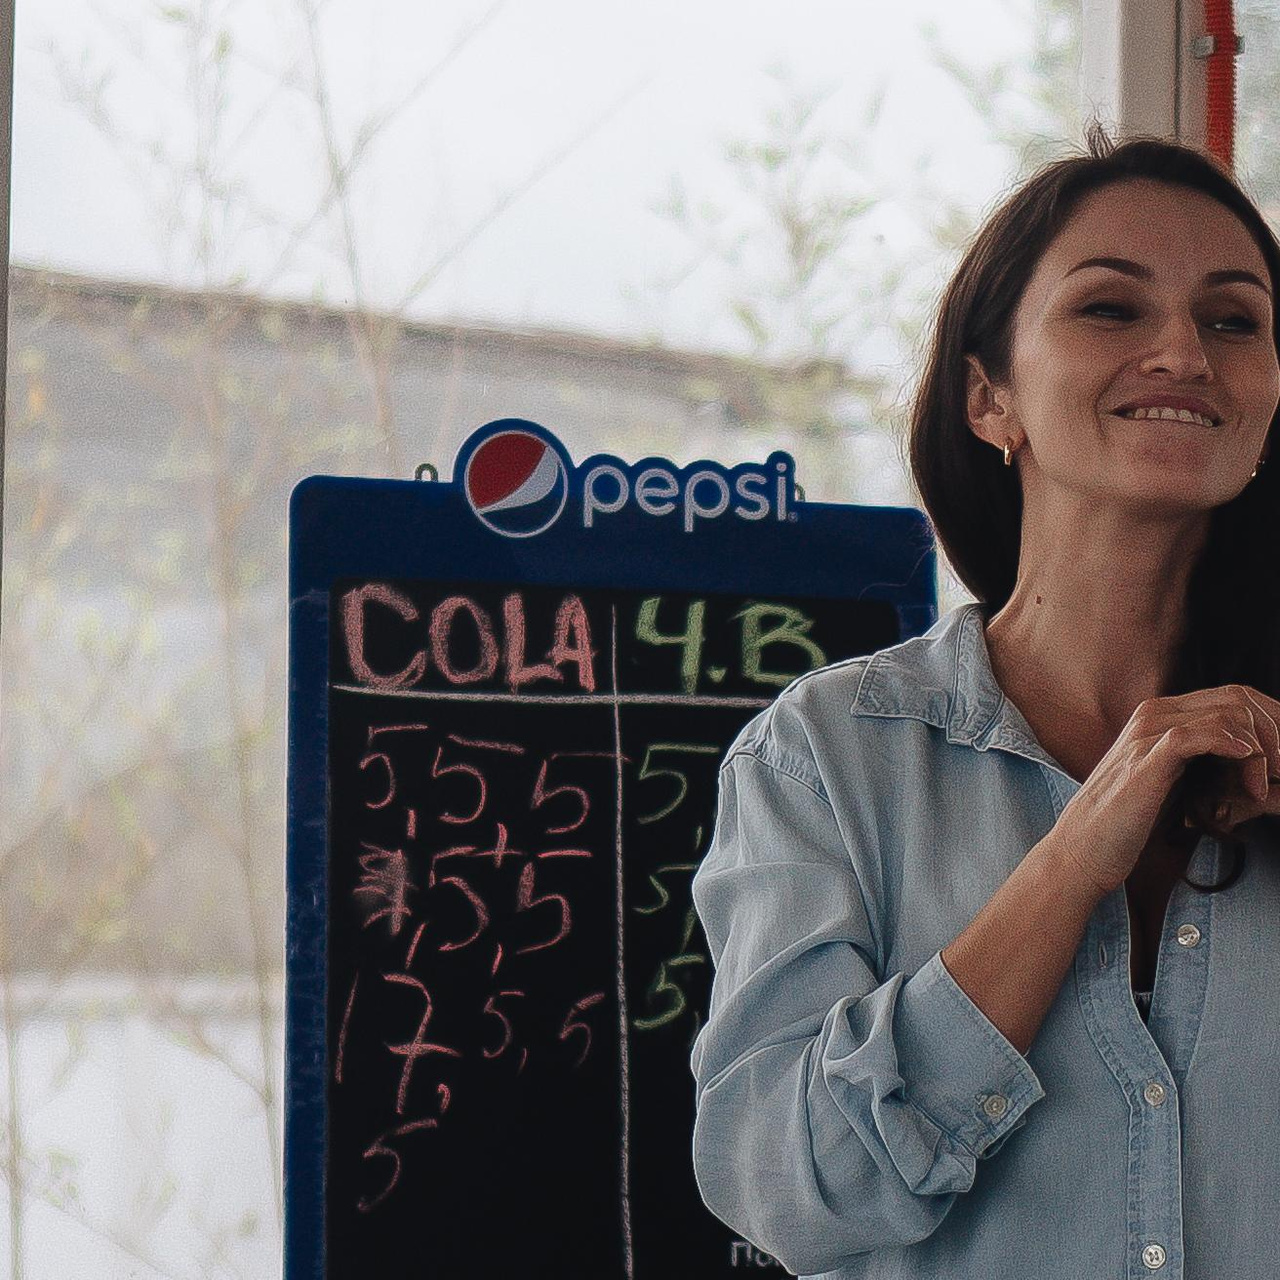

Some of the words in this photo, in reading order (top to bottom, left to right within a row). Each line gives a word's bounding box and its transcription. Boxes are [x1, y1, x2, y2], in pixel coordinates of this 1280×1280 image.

[583, 462, 789, 533] pepsi
[341, 583, 595, 694] COLA
[731, 1240, 782, 1267] По
